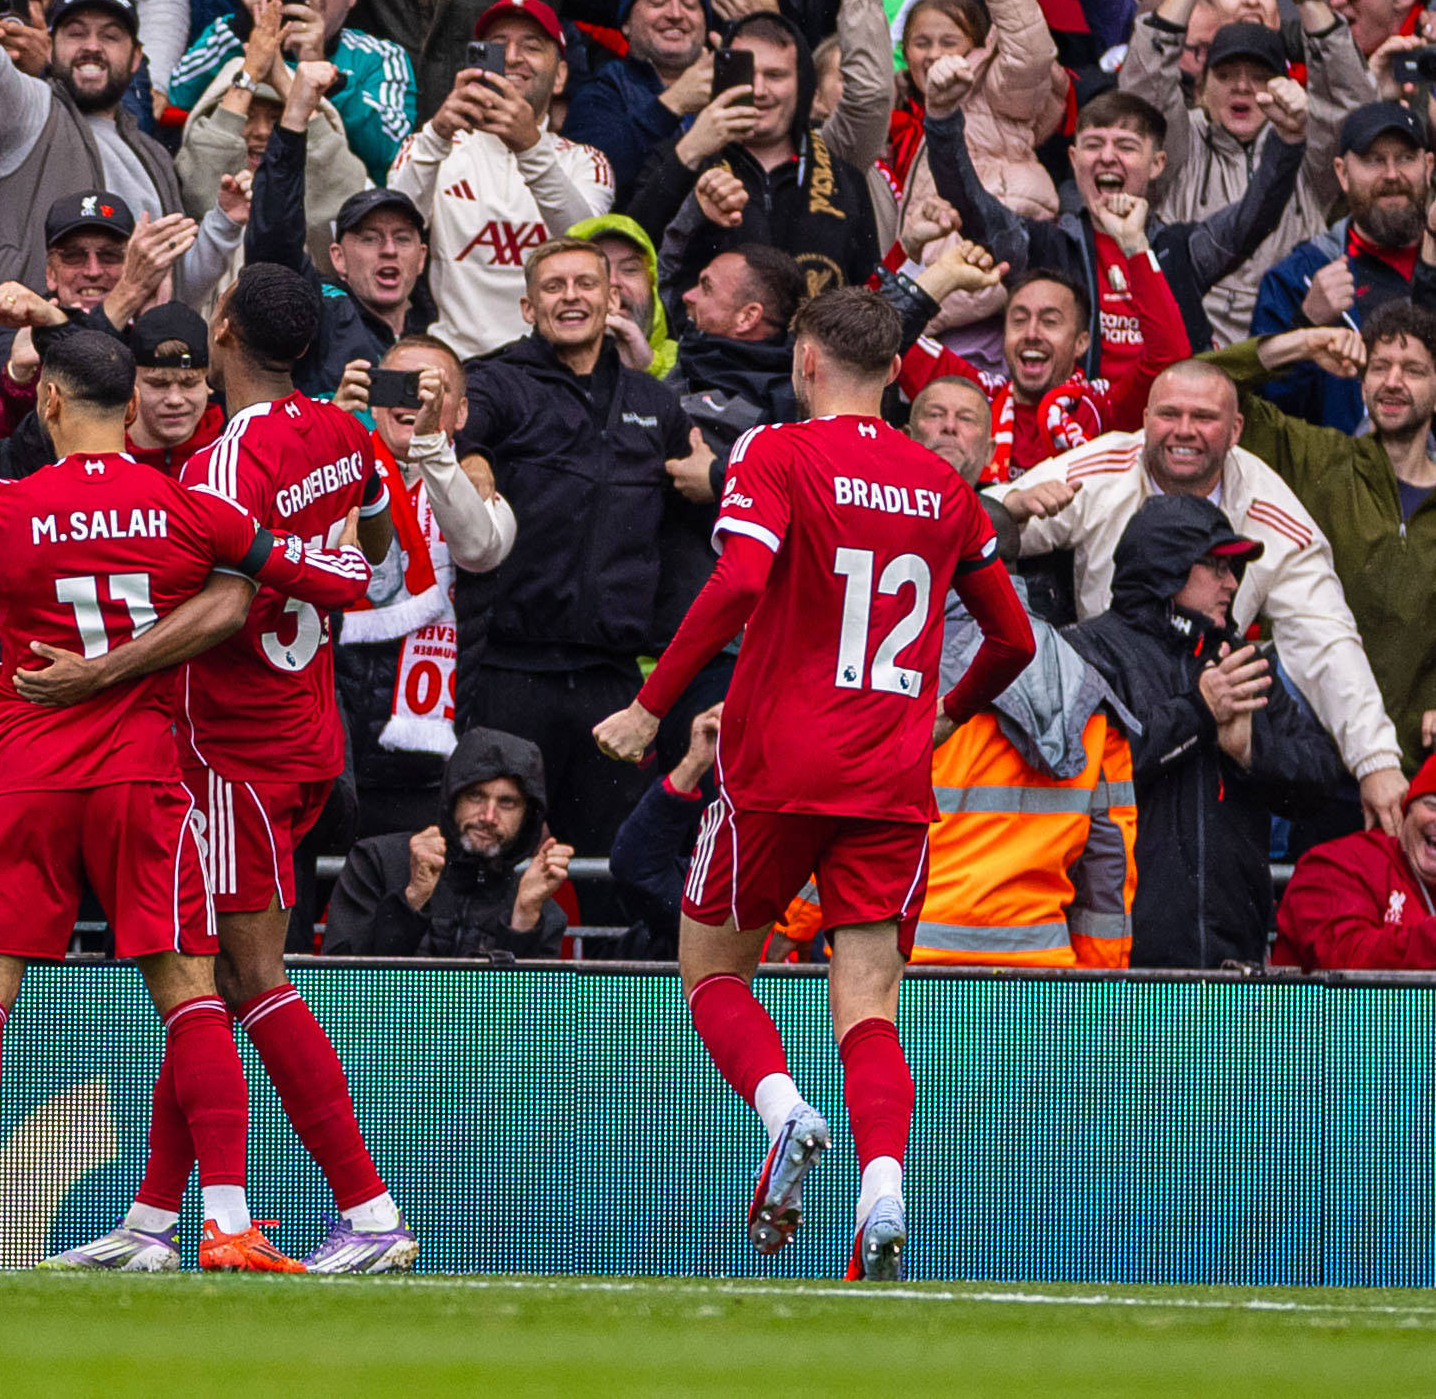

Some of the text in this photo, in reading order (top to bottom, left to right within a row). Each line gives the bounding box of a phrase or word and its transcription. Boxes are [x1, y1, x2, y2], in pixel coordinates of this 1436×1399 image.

[455, 221, 551, 267] AXA
[833, 475, 942, 521] BRADLEY
[55, 571, 159, 660] 11
[833, 546, 932, 698] 12
